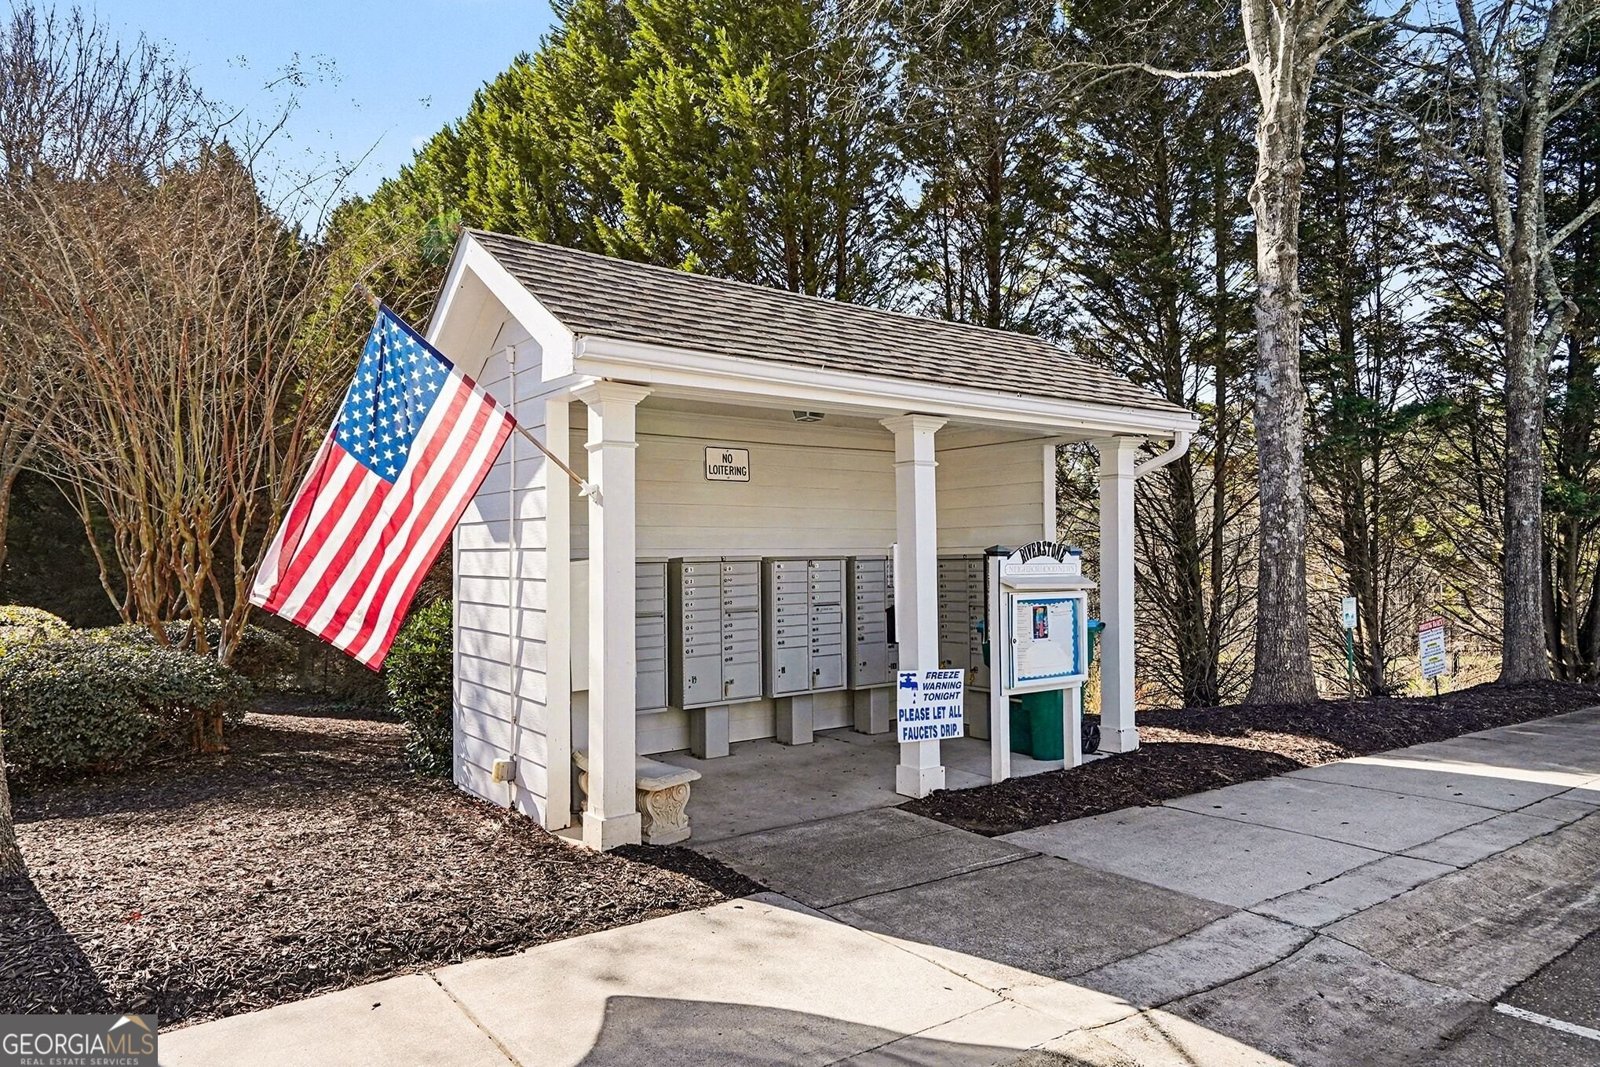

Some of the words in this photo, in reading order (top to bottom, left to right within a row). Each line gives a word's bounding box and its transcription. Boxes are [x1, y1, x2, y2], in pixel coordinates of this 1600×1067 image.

[722, 454, 733, 464] NO
[708, 465, 747, 476] LOITERING
[1019, 541, 1067, 564] RIVERSTONE
[925, 671, 960, 680] FREEZE
[922, 682, 962, 690] WARNING
[923, 692, 961, 701] TONIGHT
[899, 707, 930, 722] PLEASE
[932, 706, 946, 719] LET
[949, 705, 962, 718] ALL
[903, 726, 938, 740] FAUCETS
[940, 724, 960, 737] DRIP.
